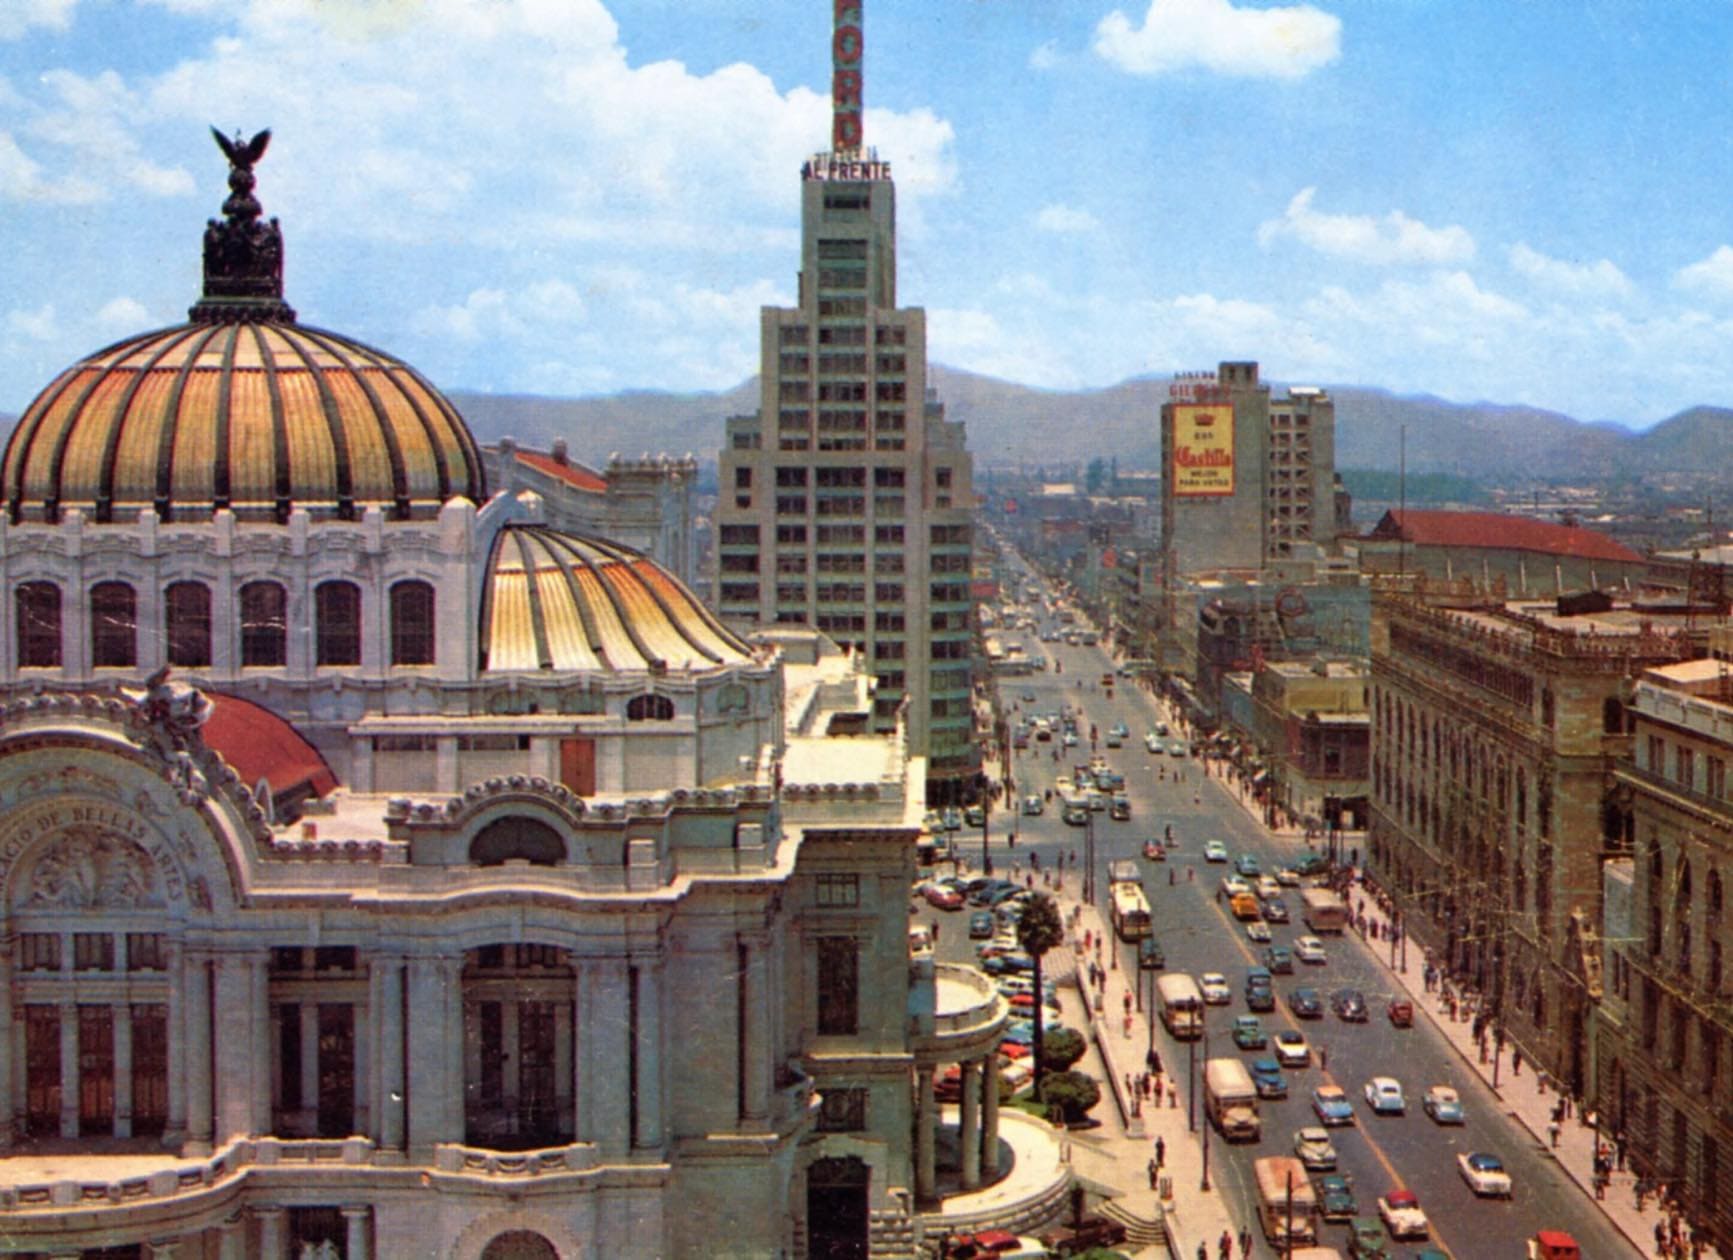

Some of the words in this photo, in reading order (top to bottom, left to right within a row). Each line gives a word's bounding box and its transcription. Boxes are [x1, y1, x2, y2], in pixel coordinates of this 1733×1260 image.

[801, 161, 825, 180] AL
[829, 161, 891, 180] FRENTE
[37, 811, 63, 833] DE
[72, 807, 147, 838] BELLAS
[150, 843, 183, 901] ARTES
